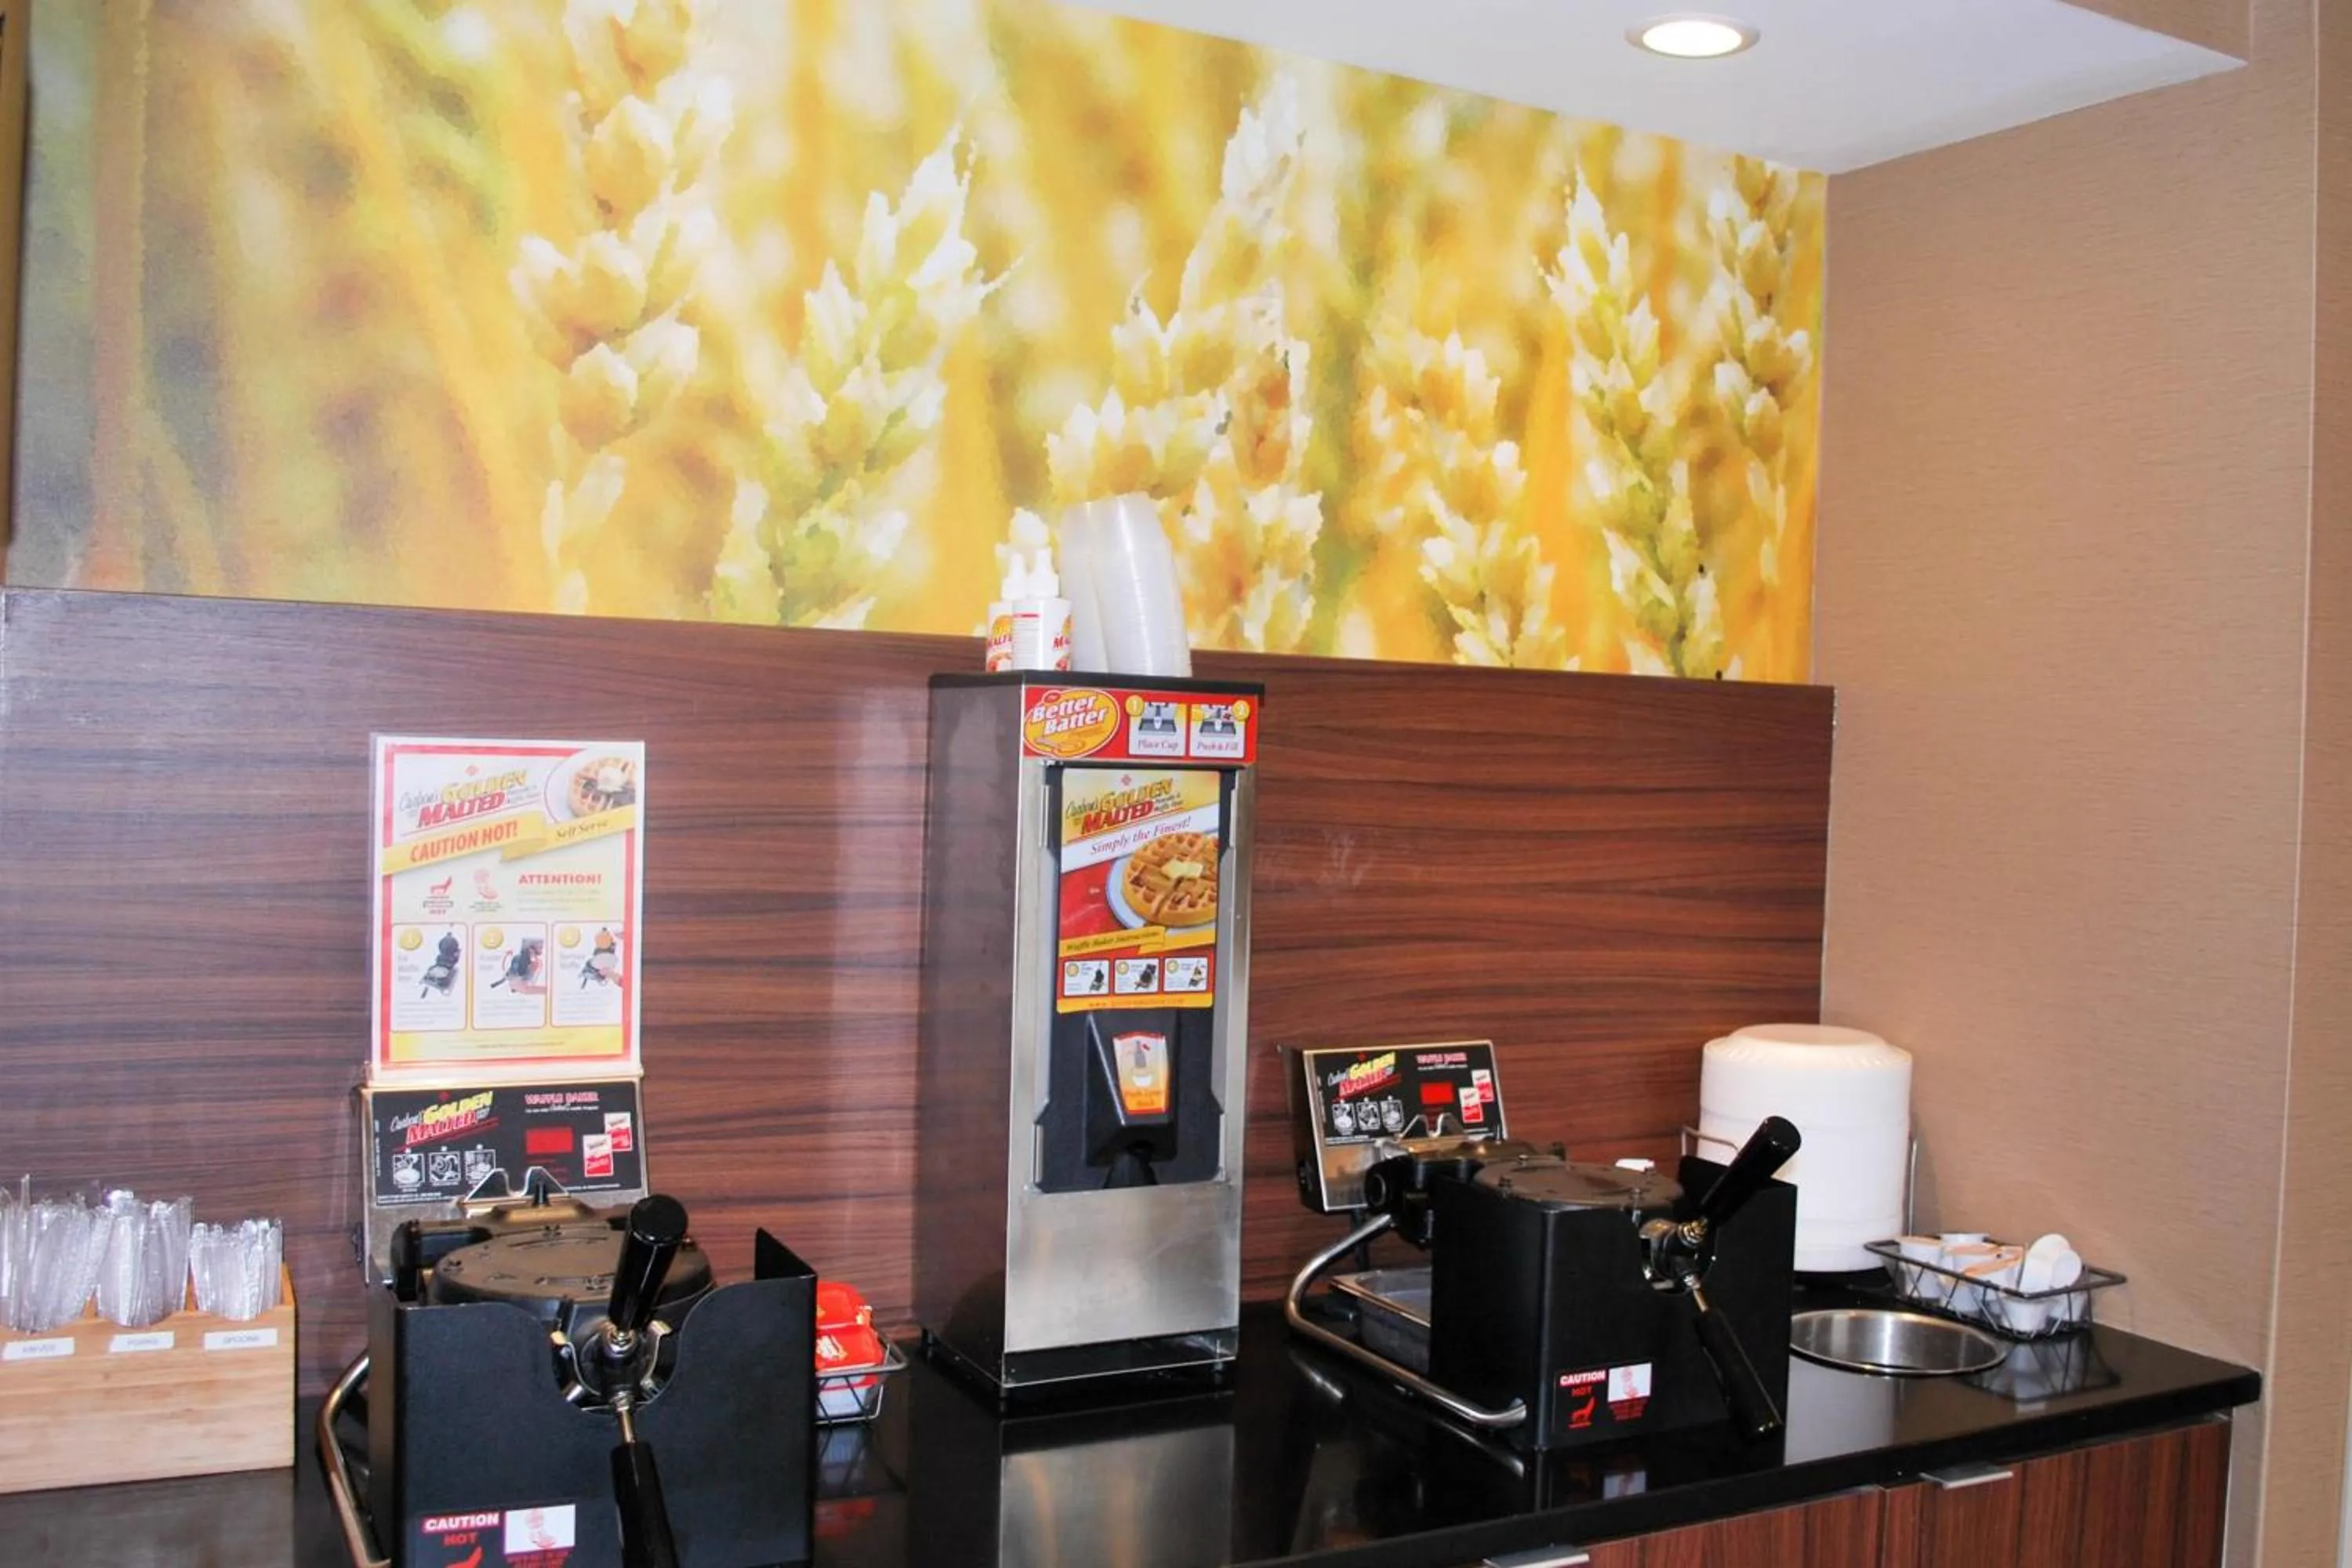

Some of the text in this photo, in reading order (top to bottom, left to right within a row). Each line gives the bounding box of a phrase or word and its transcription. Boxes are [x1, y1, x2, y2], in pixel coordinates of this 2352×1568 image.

[1031, 694, 1096, 723] Better
[1044, 707, 1107, 735] Batter
[440, 769, 527, 805] GOLDEN
[1099, 778, 1173, 813] GOLDEN
[416, 790, 506, 829] MALTED
[1081, 800, 1155, 834] MALTED
[409, 820, 518, 864] CAUTION HOT!
[1091, 815, 1192, 855] Simply the Finest!
[517, 873, 602, 886] ATTENTION!
[1348, 1052, 1396, 1080] GOLDEN
[423, 1090, 494, 1124] GOLDEN
[1559, 1370, 1606, 1387] CAUTION
[1571, 1385, 1592, 1397] HOT
[424, 1512, 499, 1531] CAUTION
[444, 1532, 477, 1546] HOT
